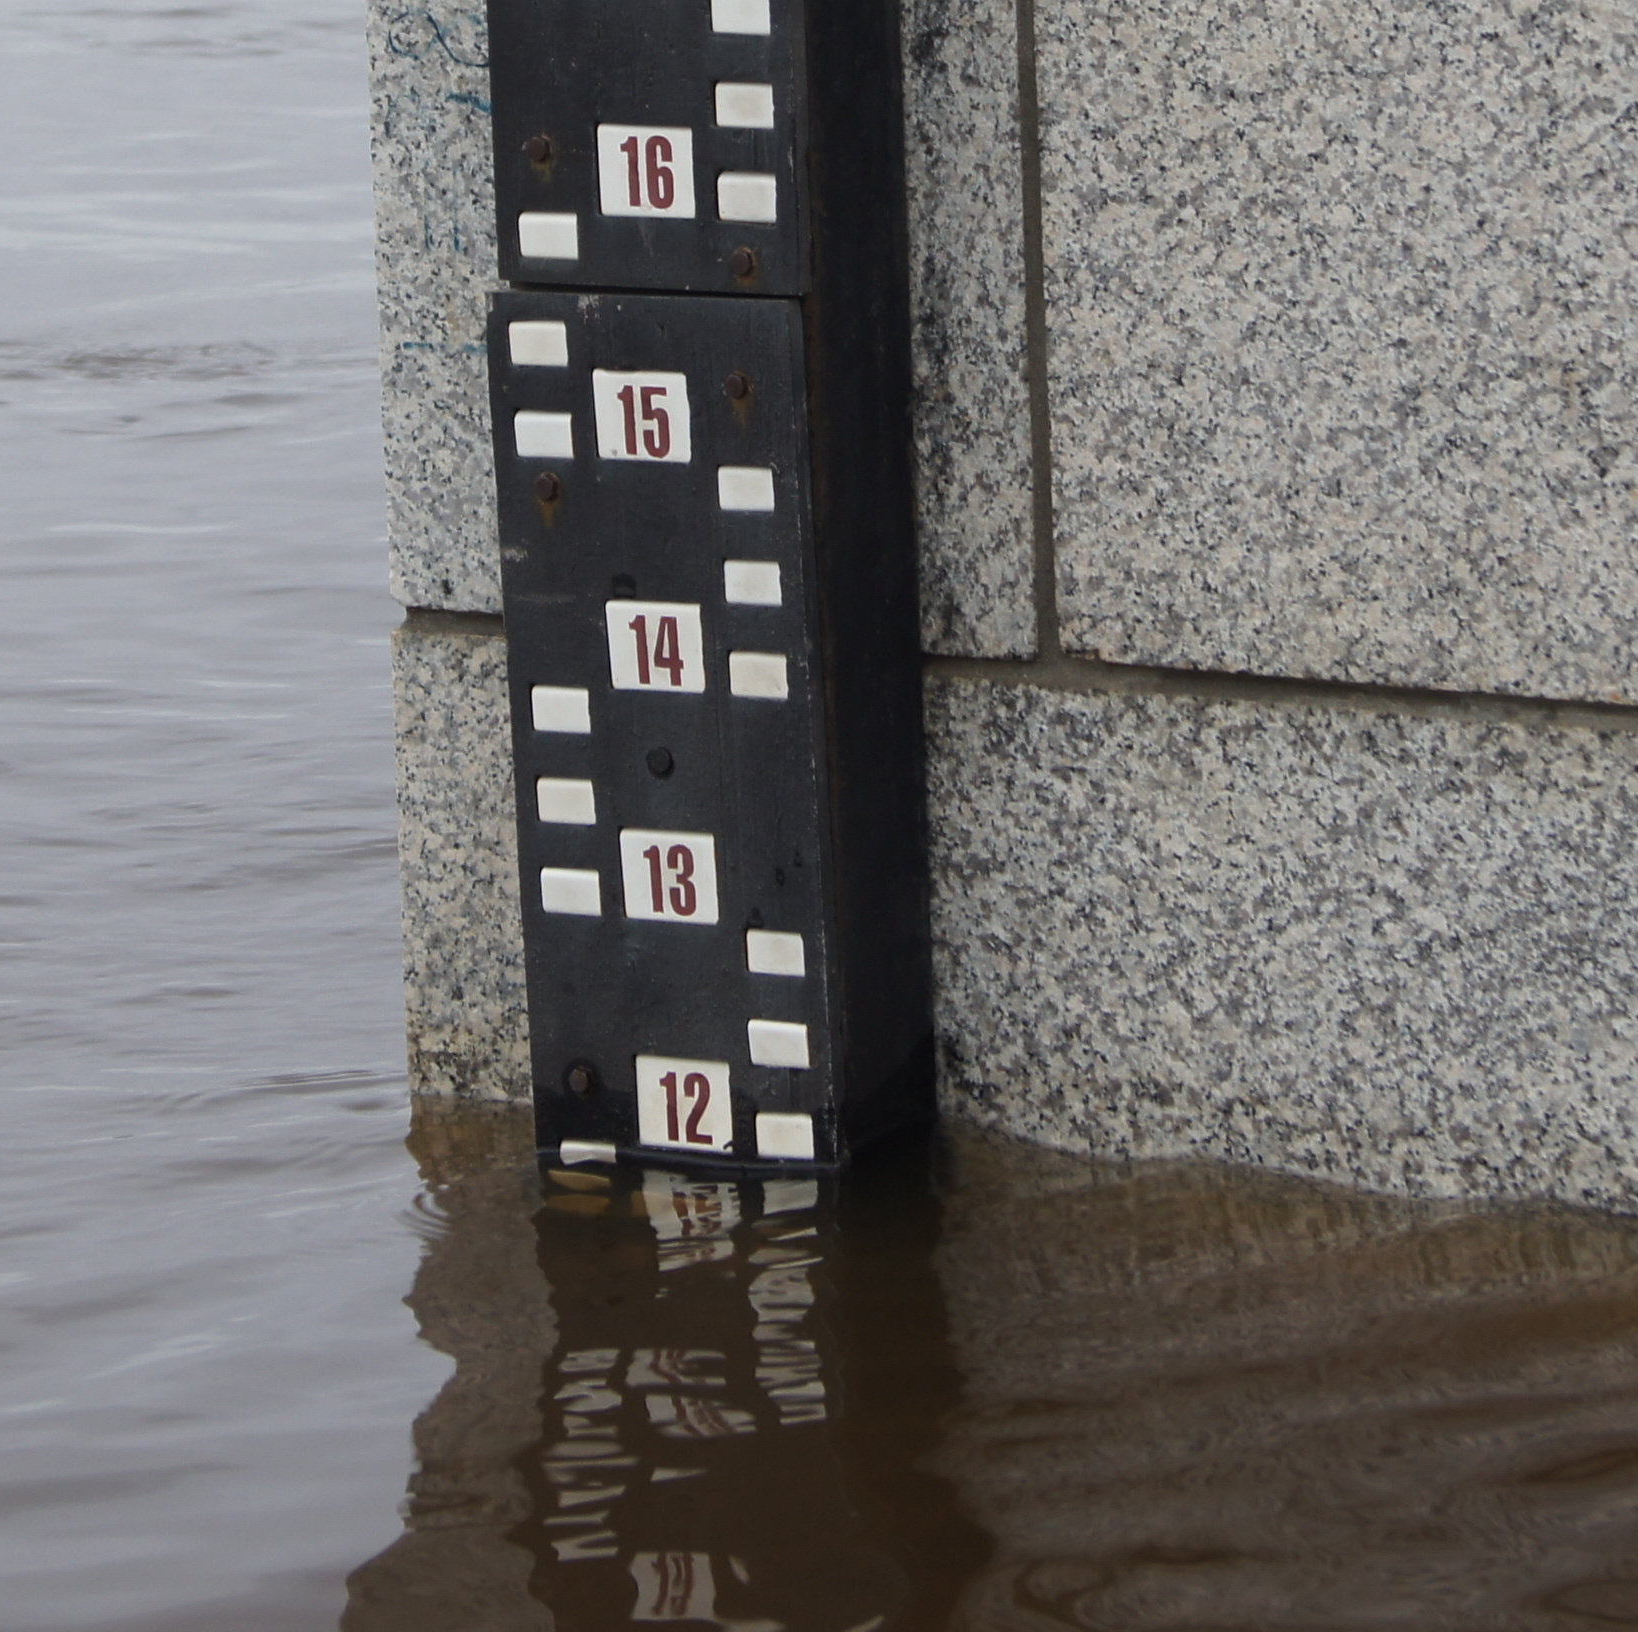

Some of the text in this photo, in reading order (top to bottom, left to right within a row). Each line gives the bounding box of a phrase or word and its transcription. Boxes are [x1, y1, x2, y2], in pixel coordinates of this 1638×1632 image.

[620, 135, 675, 209] 16
[617, 385, 671, 458] 15
[628, 615, 684, 687] 14
[643, 844, 697, 917] 13
[659, 1071, 714, 1145] 12
